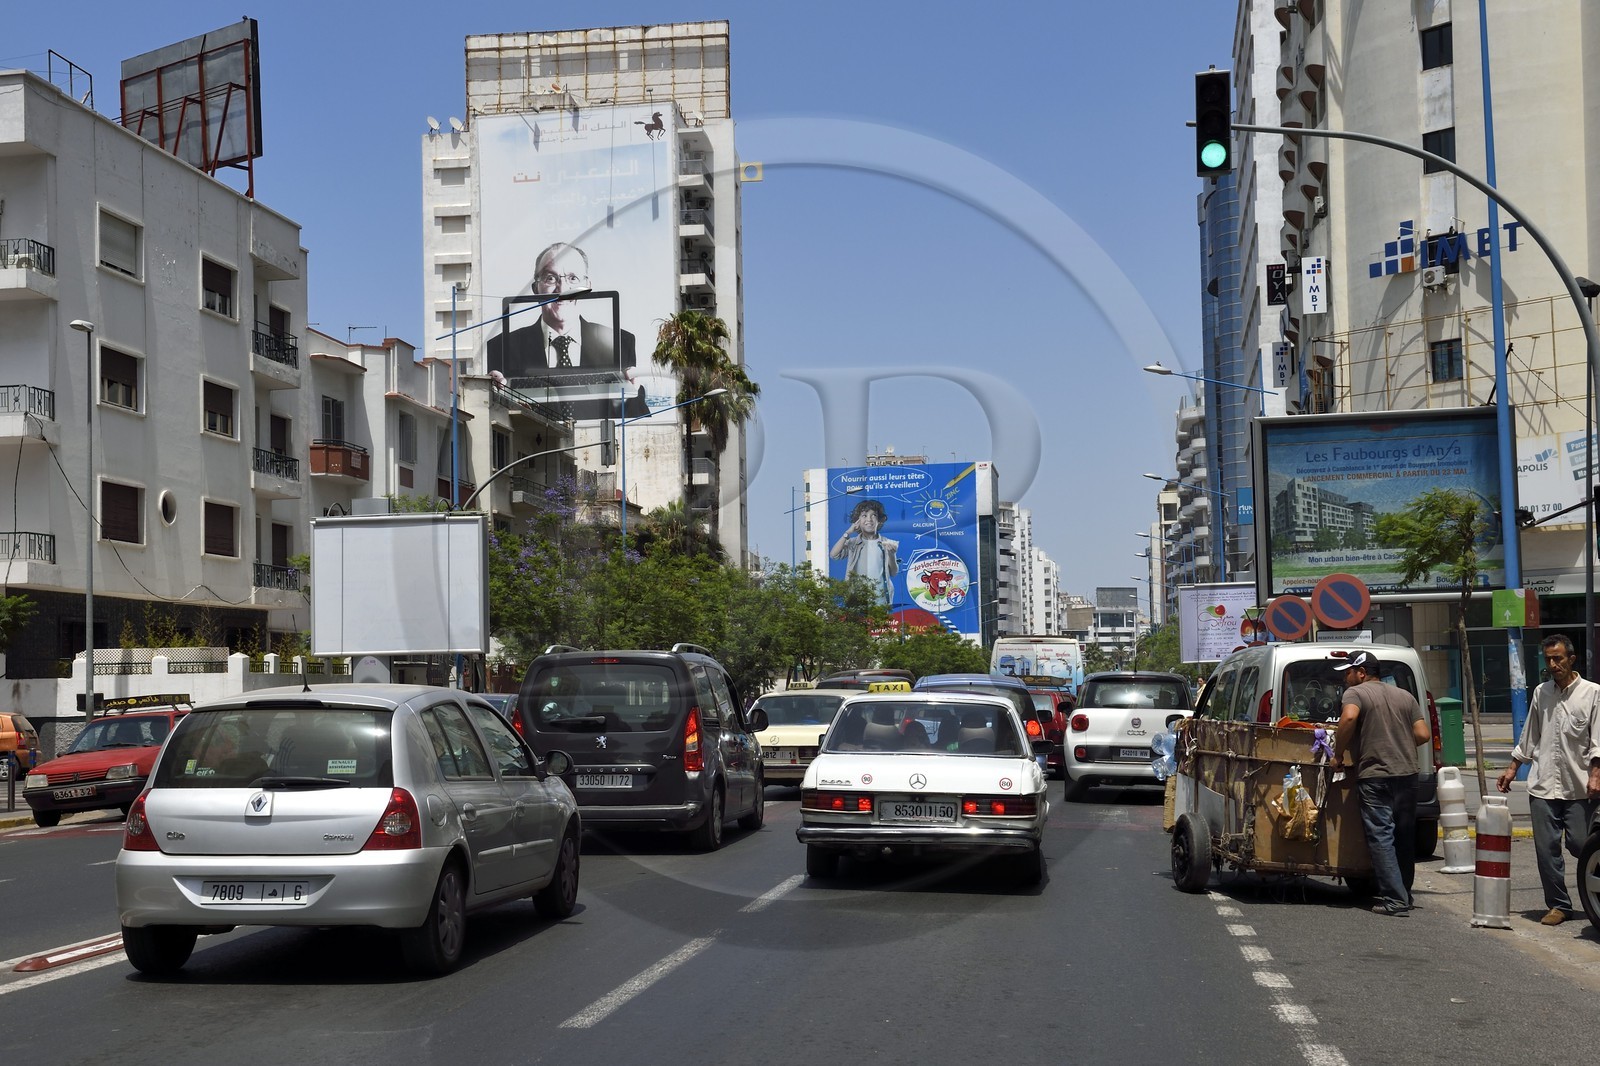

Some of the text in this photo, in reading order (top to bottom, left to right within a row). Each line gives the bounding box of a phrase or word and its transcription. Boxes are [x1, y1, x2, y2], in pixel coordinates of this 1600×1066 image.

[1420, 222, 1523, 269] IMBT
[1308, 275, 1320, 312] IMBT
[1277, 356, 1287, 386] IMBT
[1305, 440, 1461, 463] Les Faubourgs d'Anfa
[1381, 463, 1399, 471] projet
[1408, 461, 1436, 469] Bouygues
[1437, 459, 1468, 467] Immobilier
[841, 475, 867, 483] Nourrir
[869, 473, 887, 482] aussi
[907, 472, 925, 480] têtes
[1303, 474, 1345, 483] LANCEMENT
[1346, 473, 1393, 481] COMMERCIAL
[1403, 469, 1428, 478] PARTIR
[865, 482, 883, 492] qu'ils
[884, 480, 919, 489] s'éveillent
[945, 486, 960, 500] ZINC
[1541, 504, 1551, 512] 37
[1553, 503, 1562, 511] 00
[1324, 555, 1344, 563] urban
[1345, 552, 1376, 562] bien-être
[579, 775, 605, 786] 33050
[620, 775, 629, 786] 72
[54, 790, 73, 799] 8361
[894, 804, 922, 817] 8530
[939, 806, 954, 818] 50
[212, 884, 244, 901] 7809
[293, 884, 303, 901] 6
